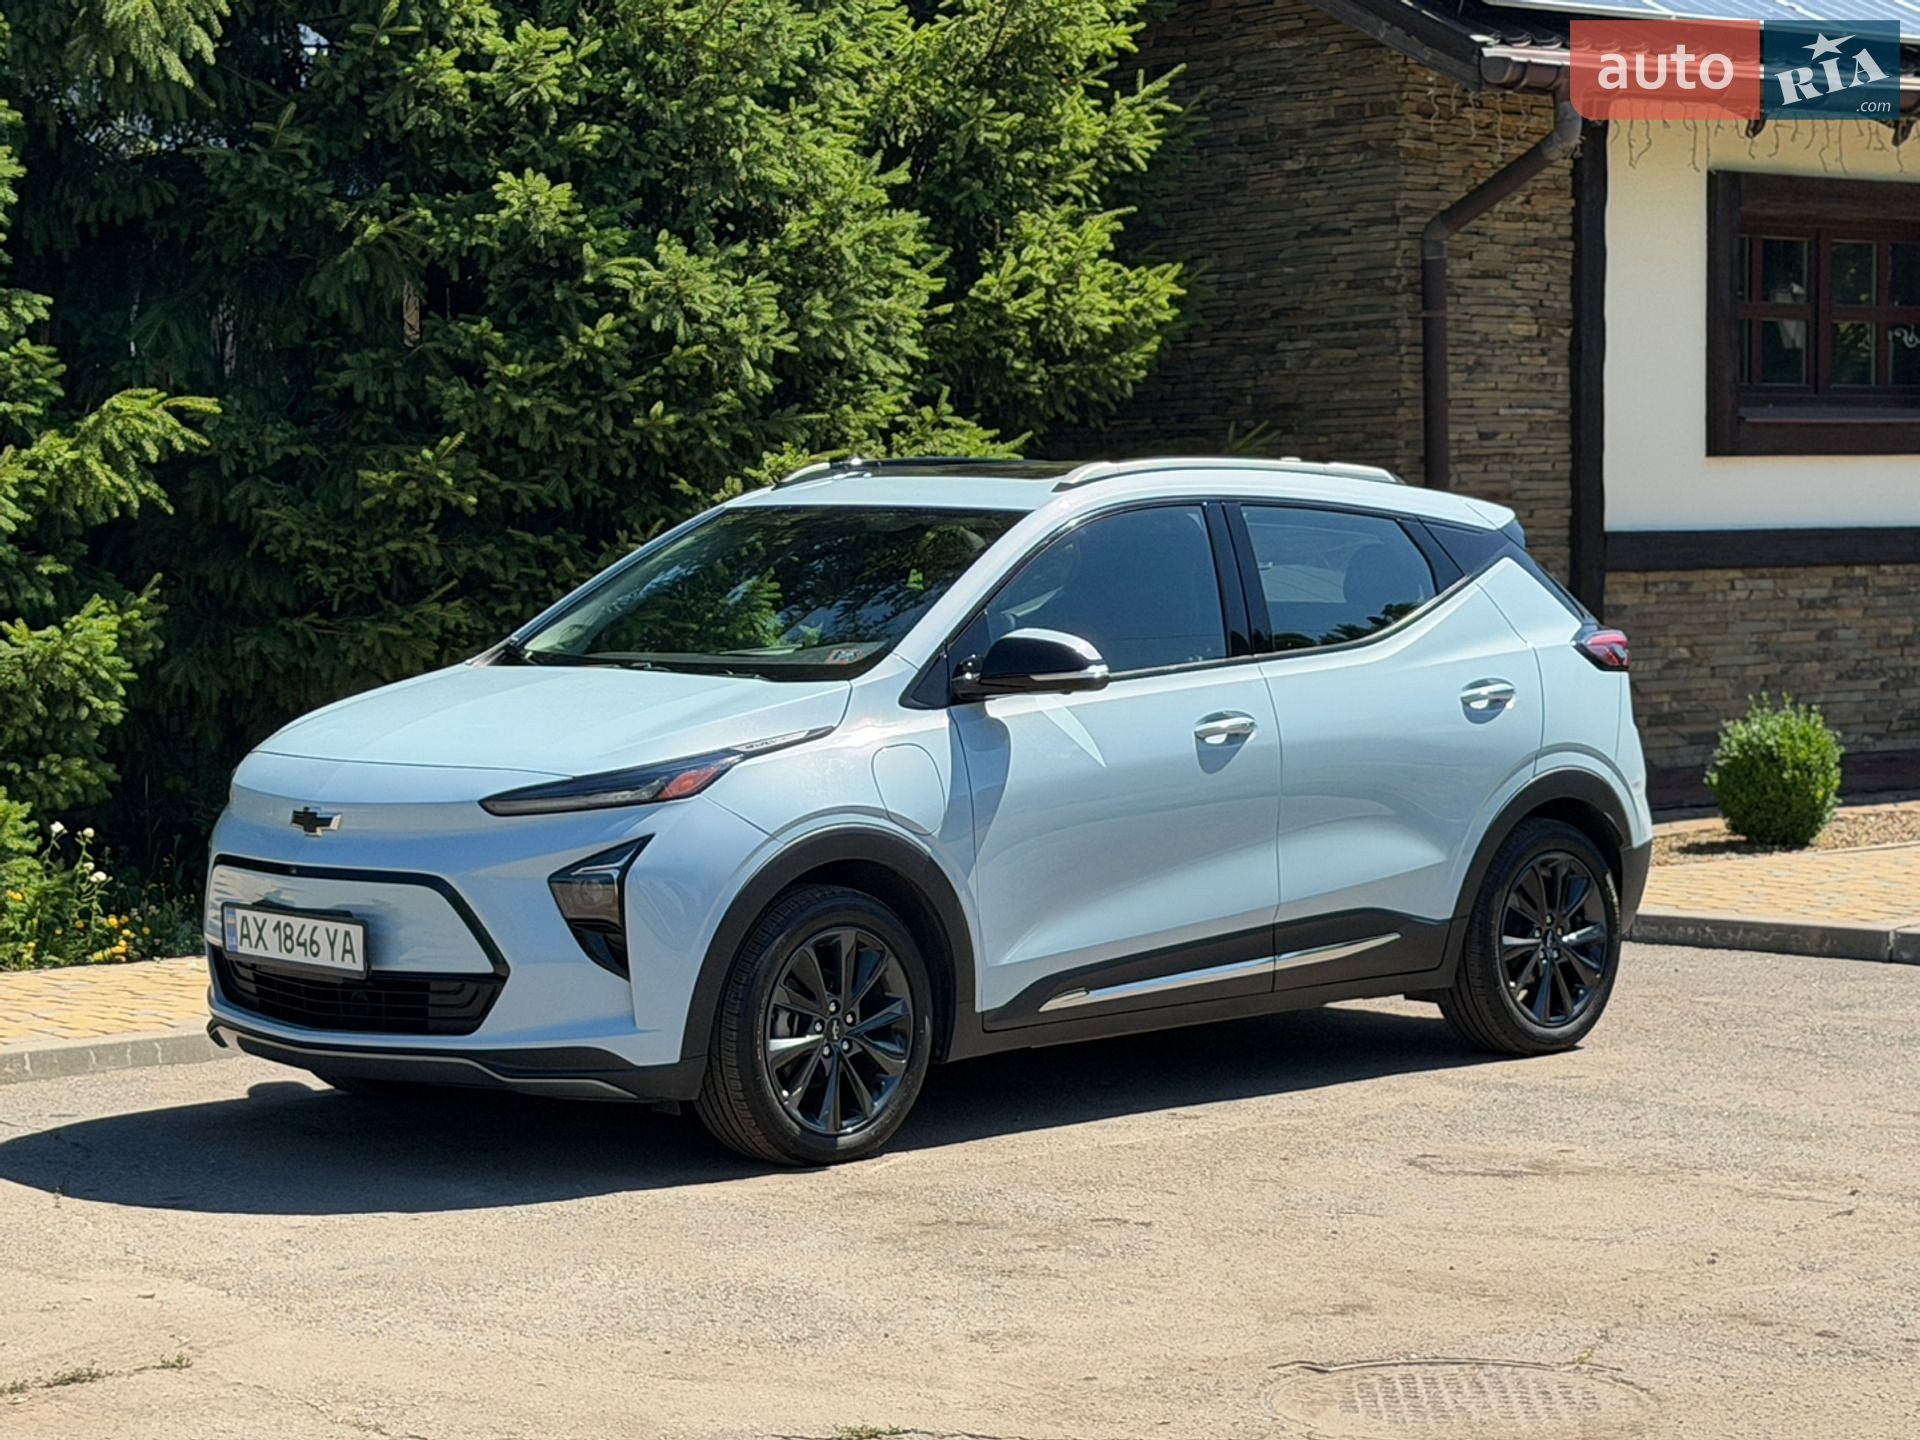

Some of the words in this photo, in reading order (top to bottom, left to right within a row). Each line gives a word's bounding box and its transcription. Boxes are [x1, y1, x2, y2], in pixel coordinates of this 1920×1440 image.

[239, 915, 268, 951] AX
[273, 920, 321, 958] 1846
[325, 927, 356, 964] YA
